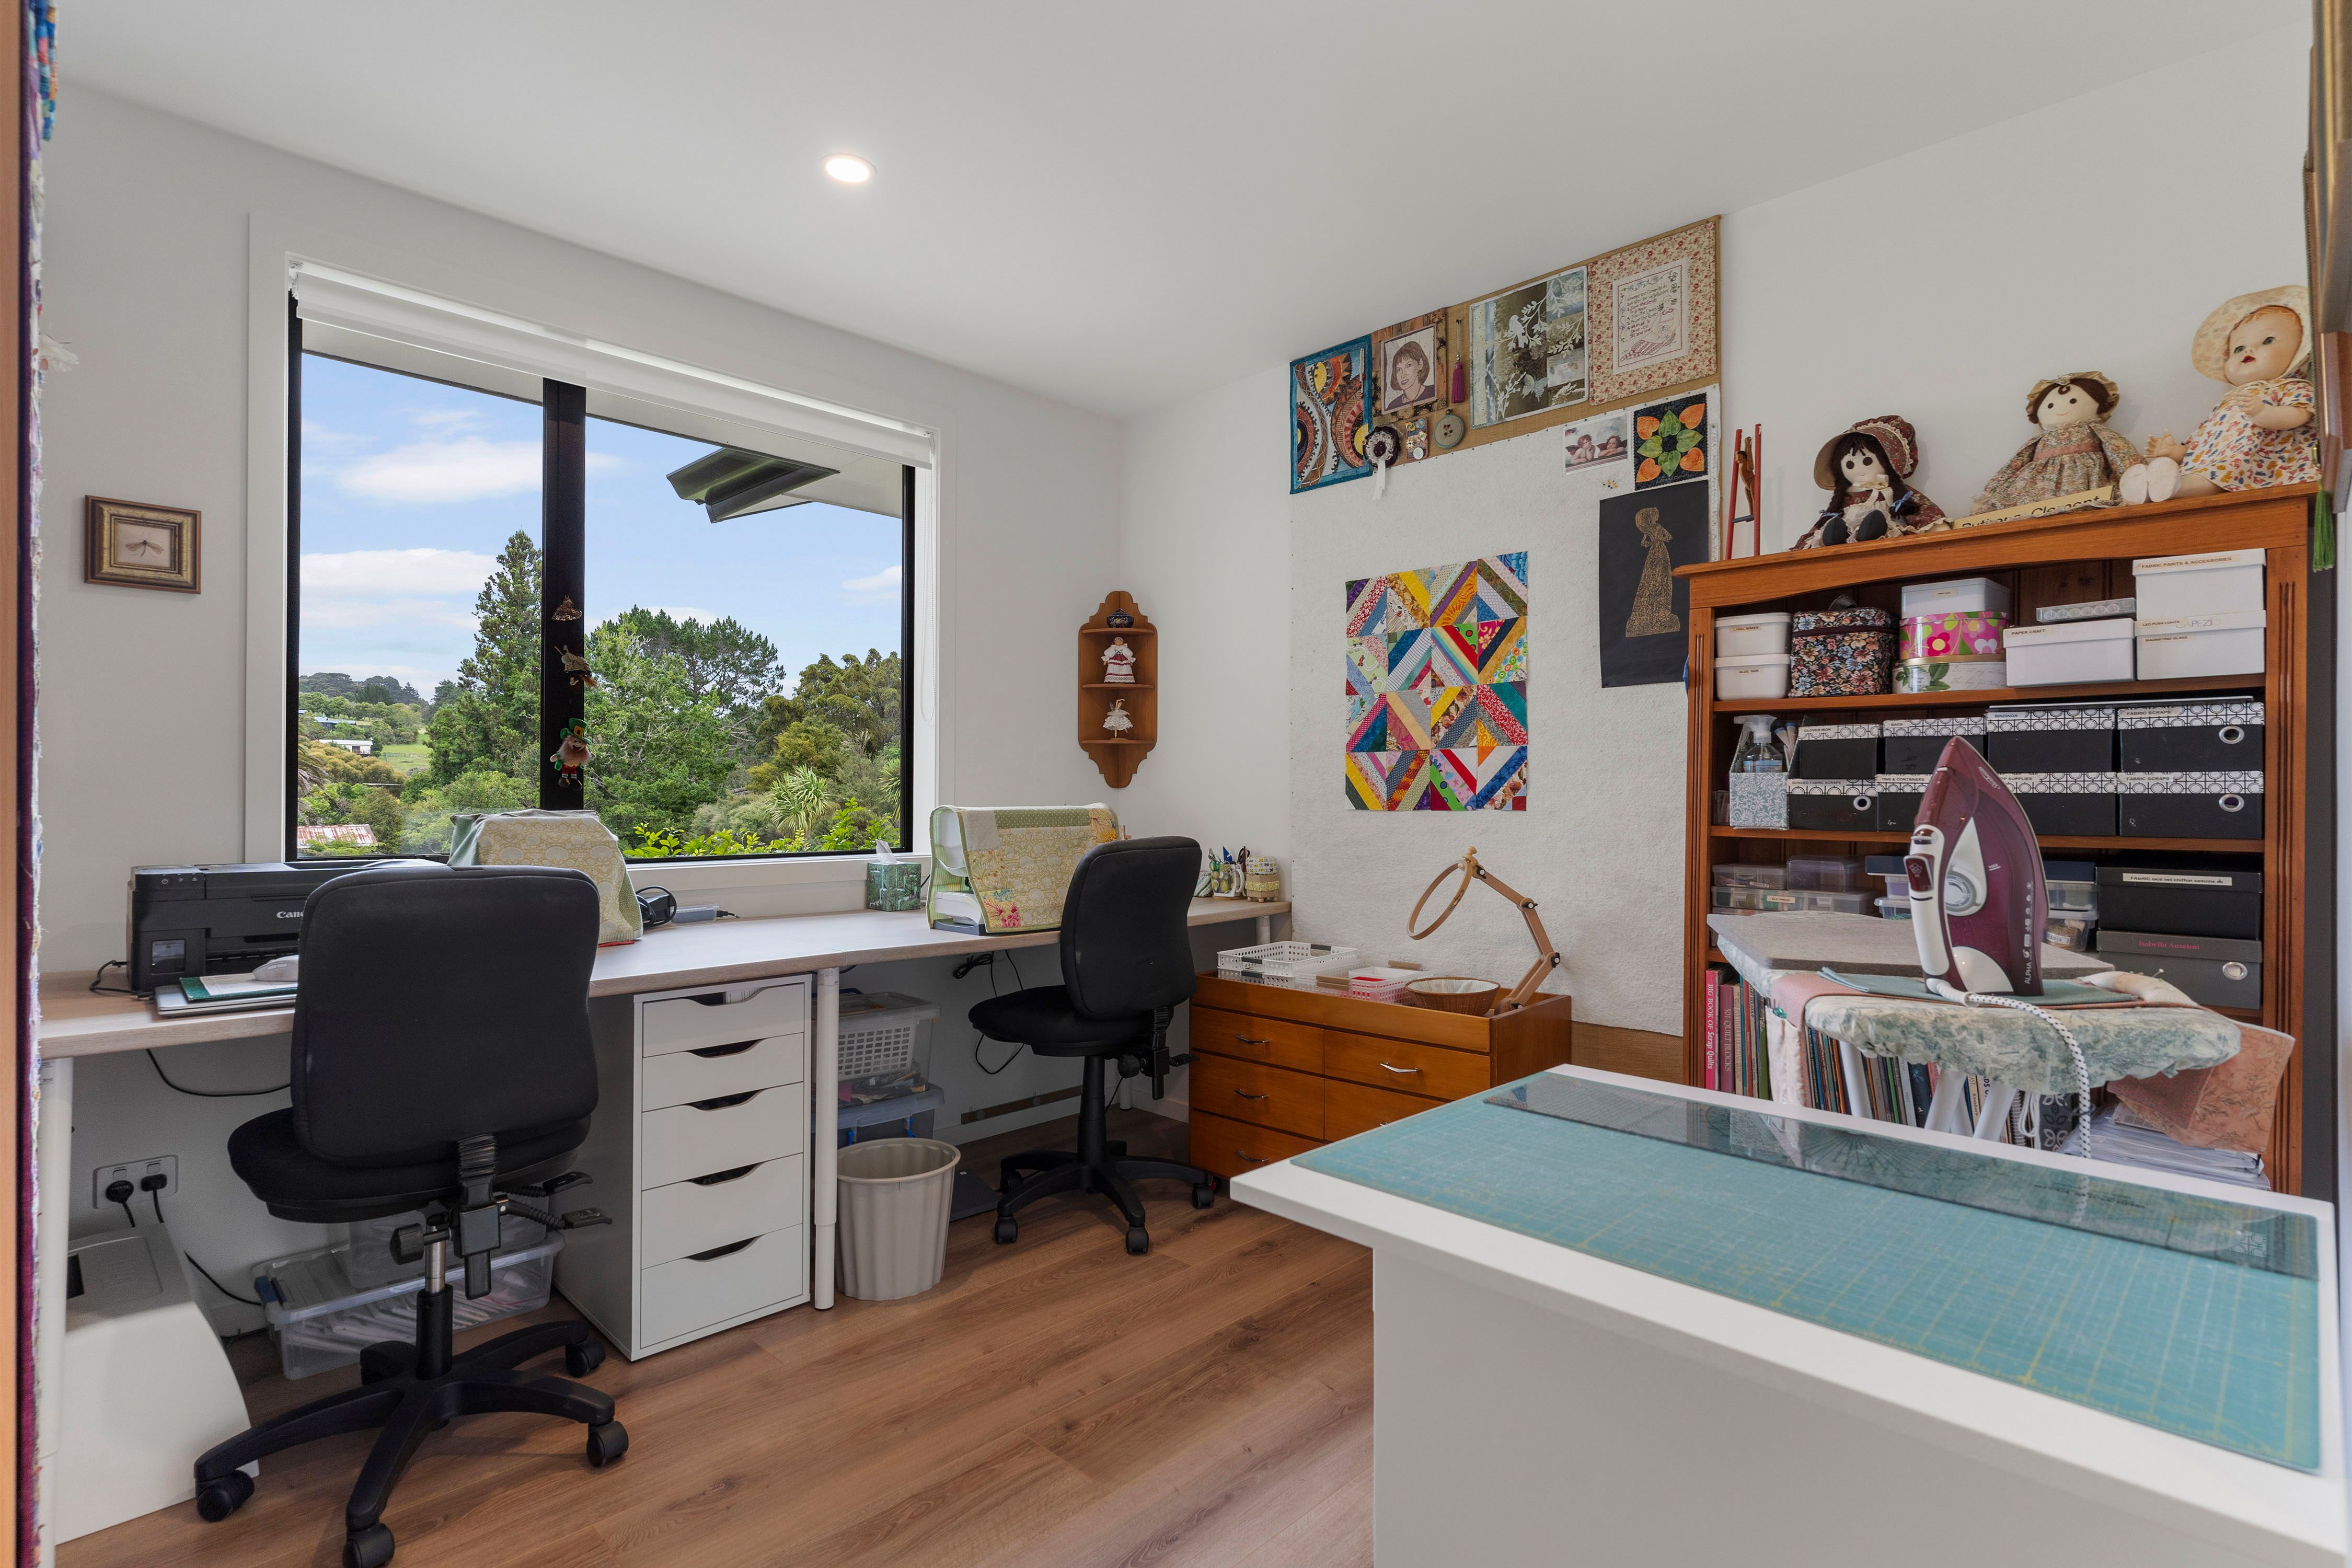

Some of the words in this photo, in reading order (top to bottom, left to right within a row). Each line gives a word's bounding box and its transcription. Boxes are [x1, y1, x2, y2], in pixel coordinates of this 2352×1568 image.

[1707, 1020, 1714, 1030] OF
[1723, 1019, 1732, 1045] QUILT
[1706, 1031, 1715, 1050] Scrap
[1707, 1050, 1715, 1070] Quilts
